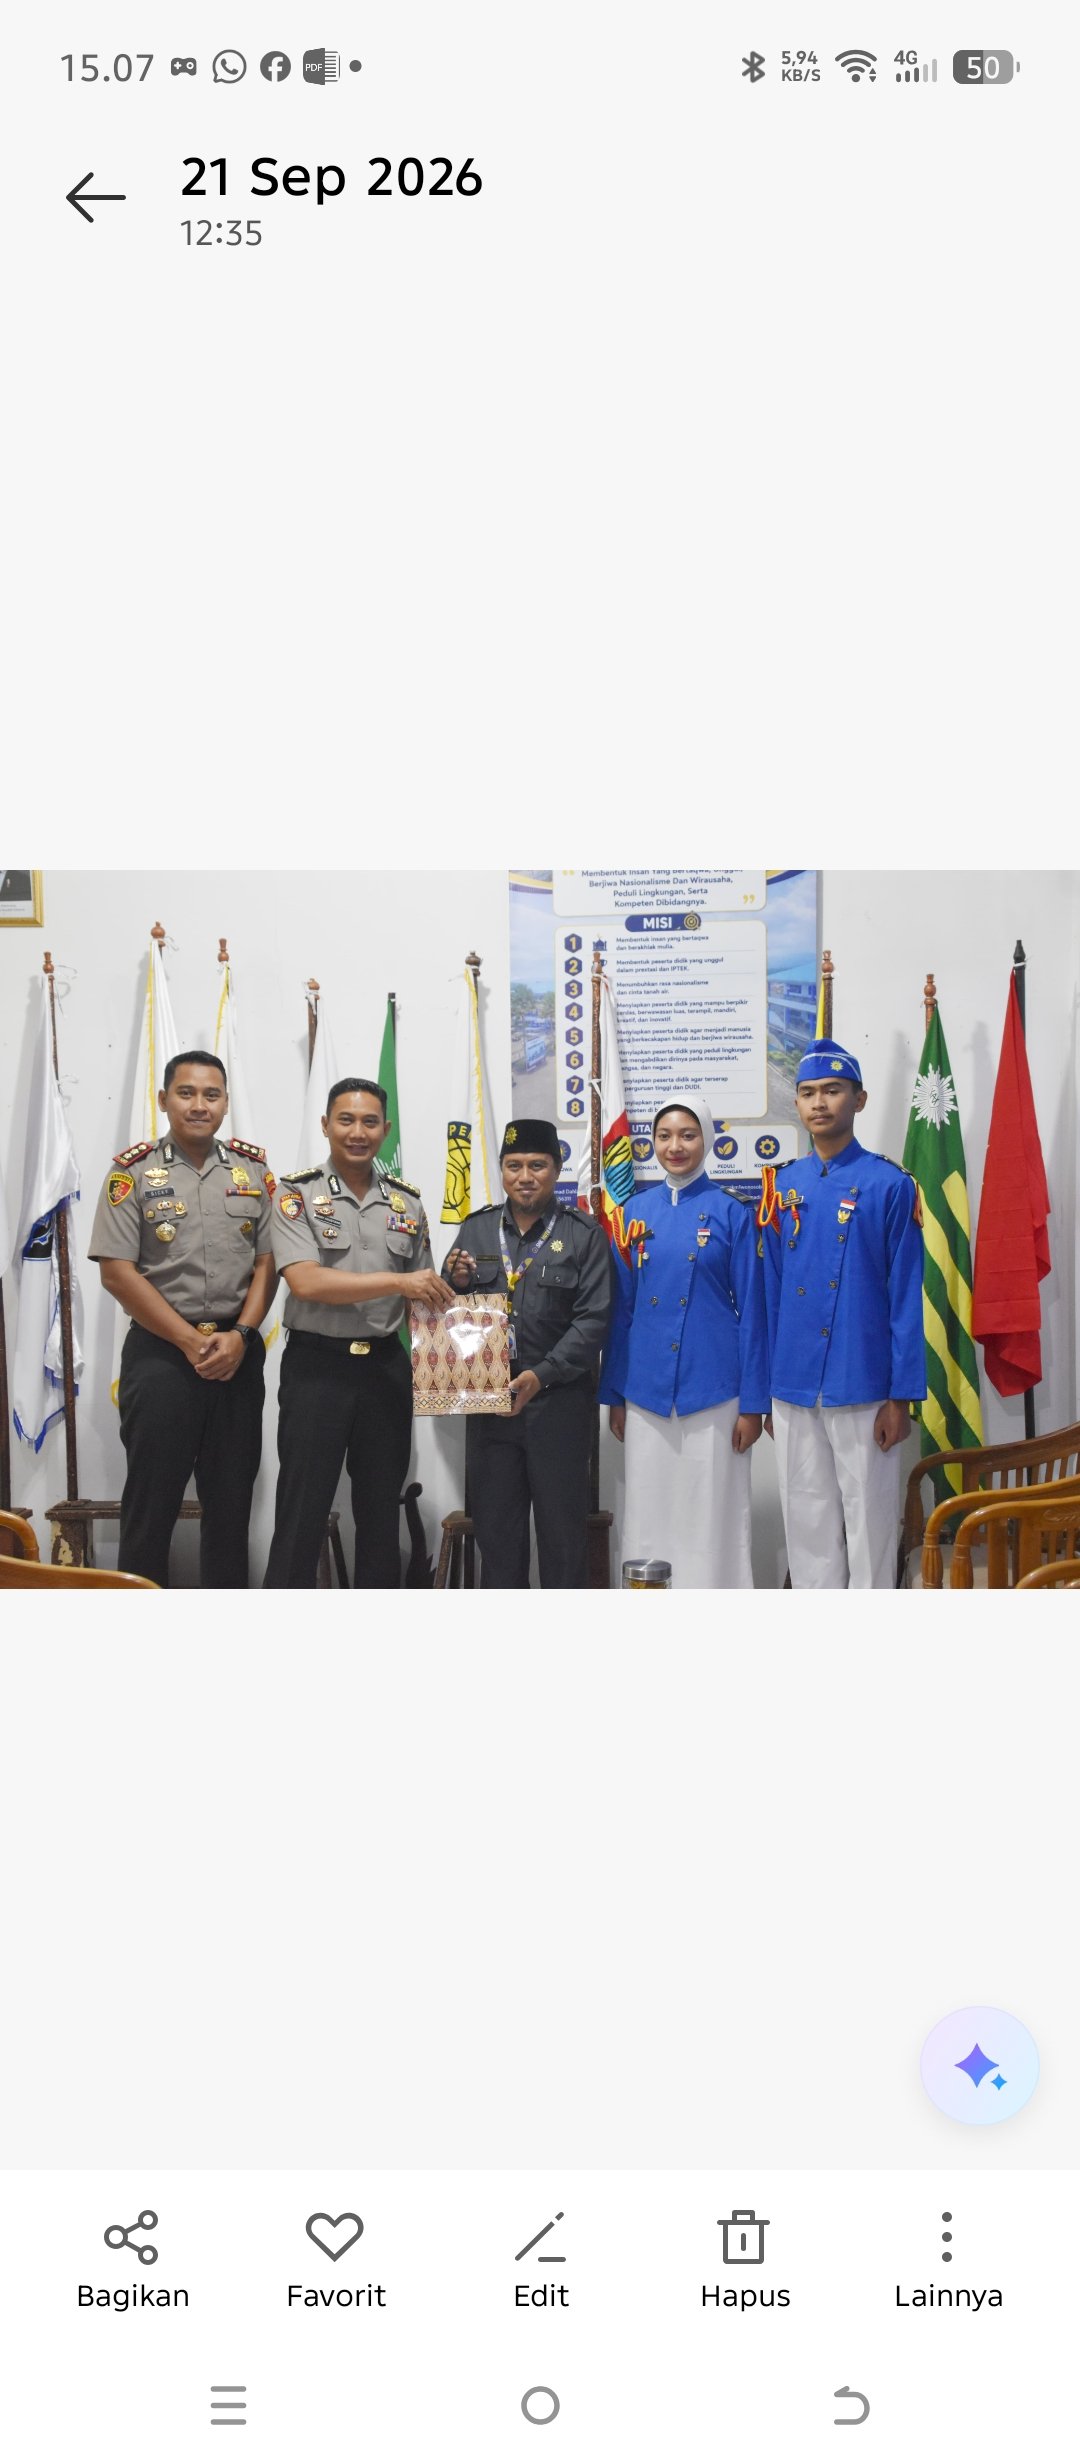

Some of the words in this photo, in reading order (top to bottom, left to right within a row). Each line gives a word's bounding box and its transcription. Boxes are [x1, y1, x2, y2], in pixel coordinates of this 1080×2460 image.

[781, 50, 818, 66] 5,94
[894, 50, 918, 65] 4G
[61, 54, 154, 82] 15.07
[305, 63, 323, 72] PDF
[966, 56, 1000, 79] 50
[781, 69, 821, 82] KB/S
[181, 156, 227, 196] 21
[250, 156, 346, 206] Sep
[367, 156, 483, 197] 2026
[180, 220, 263, 247] 12:35
[589, 880, 618, 888] Berjiwa
[619, 878, 671, 887] Nasionalisme
[672, 877, 688, 885] Dan
[690, 876, 733, 884] Wirausaha,
[613, 889, 637, 897] Peduli
[639, 888, 686, 898] Lingkungan,
[688, 887, 708, 895] Serta
[614, 900, 654, 908] Kompeten
[656, 898, 707, 907] Dibidangnya.
[643, 917, 672, 930] MISI
[569, 937, 577, 949] 1
[569, 960, 578, 973] 2
[569, 983, 578, 996] 3
[569, 1006, 578, 1018] 4
[570, 1031, 579, 1043] 5
[570, 1054, 579, 1067] 6
[571, 1079, 580, 1092] 7
[570, 1101, 580, 1114] 8
[78, 2283, 189, 2313] Bagikan
[287, 2283, 387, 2308] Favorit
[514, 2283, 570, 2308] Edit
[702, 2284, 791, 2313] Hapus
[896, 2283, 1003, 2313] Lainnya
